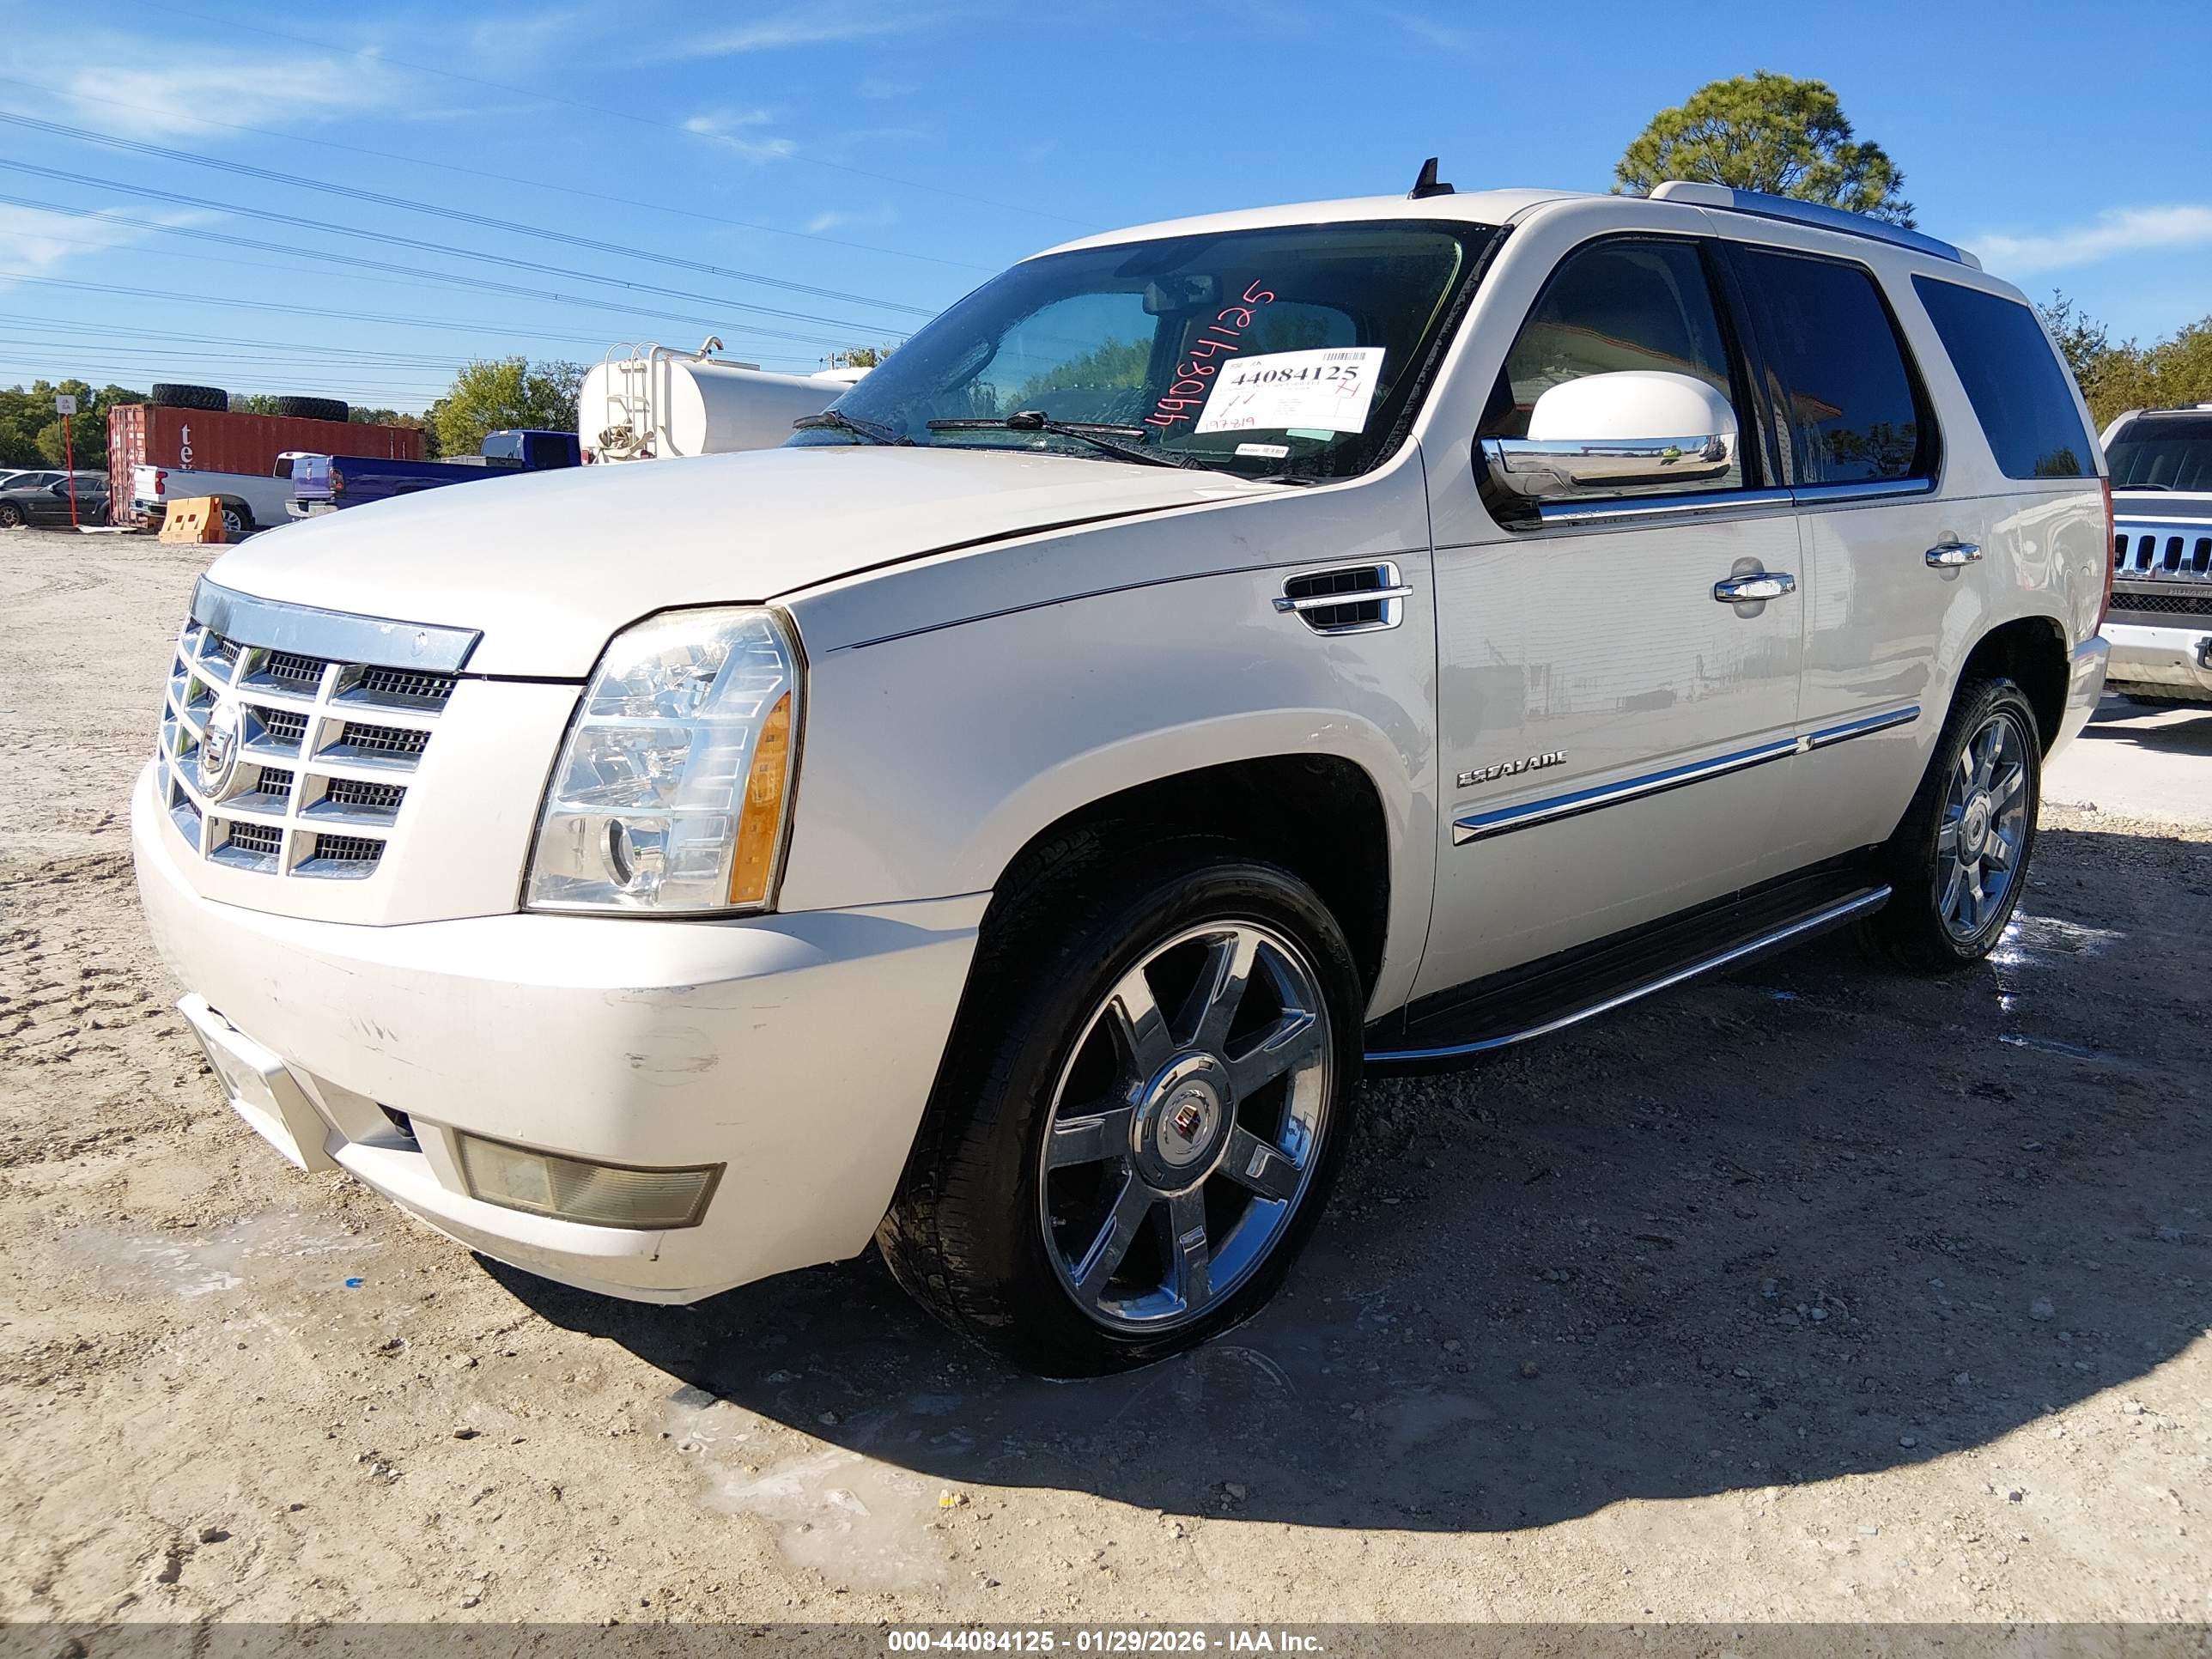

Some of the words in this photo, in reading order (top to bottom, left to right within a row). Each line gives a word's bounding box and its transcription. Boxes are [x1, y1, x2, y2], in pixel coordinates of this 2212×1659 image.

[1145, 279, 1275, 426] 44084125
[1231, 366, 1359, 386] 44084125
[1456, 750, 1567, 788] ESCALADE
